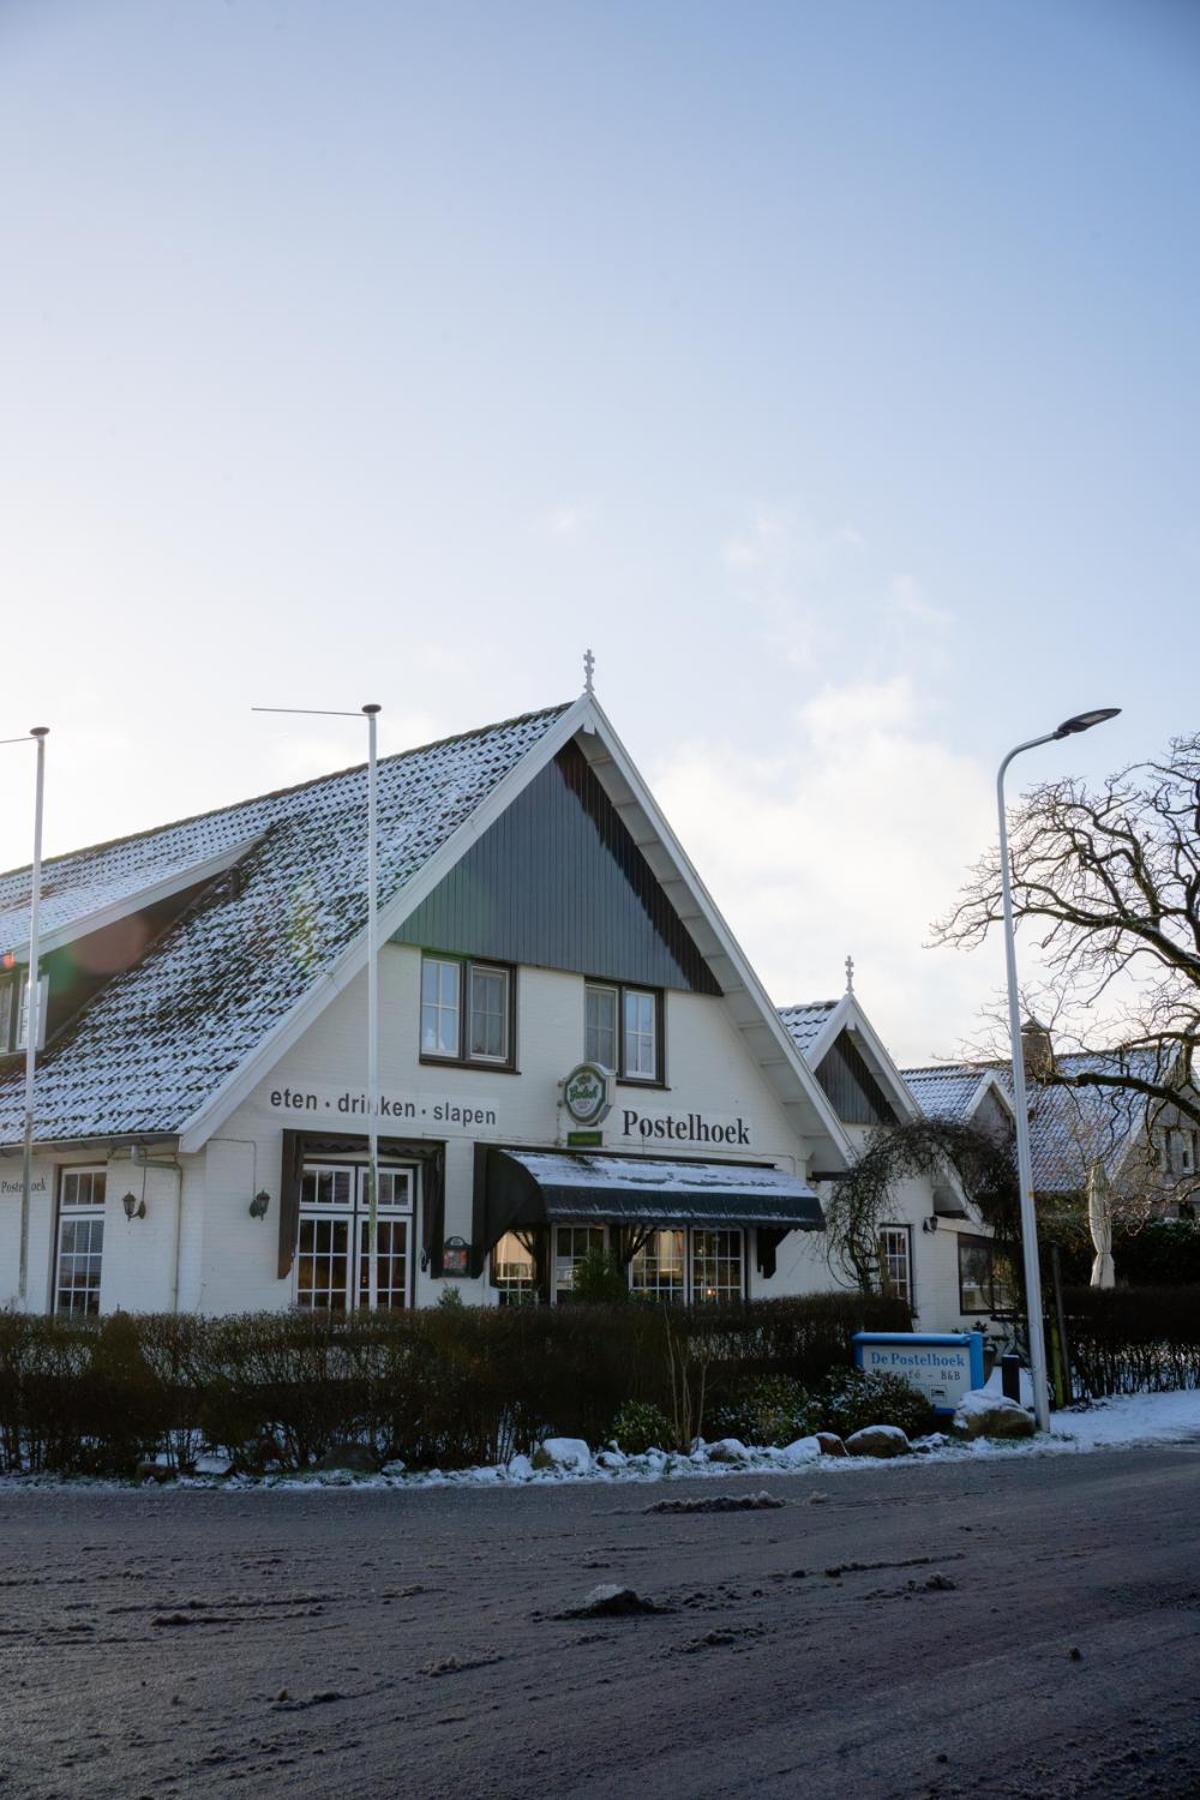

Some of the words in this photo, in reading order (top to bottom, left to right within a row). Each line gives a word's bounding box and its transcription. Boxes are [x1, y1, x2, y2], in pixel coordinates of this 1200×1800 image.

[270, 1088, 317, 1110] eten
[433, 1102, 496, 1127] slapen
[622, 1110, 750, 1145] Postelhoek
[871, 1352, 888, 1365] De
[891, 1353, 965, 1367] Postelhoek
